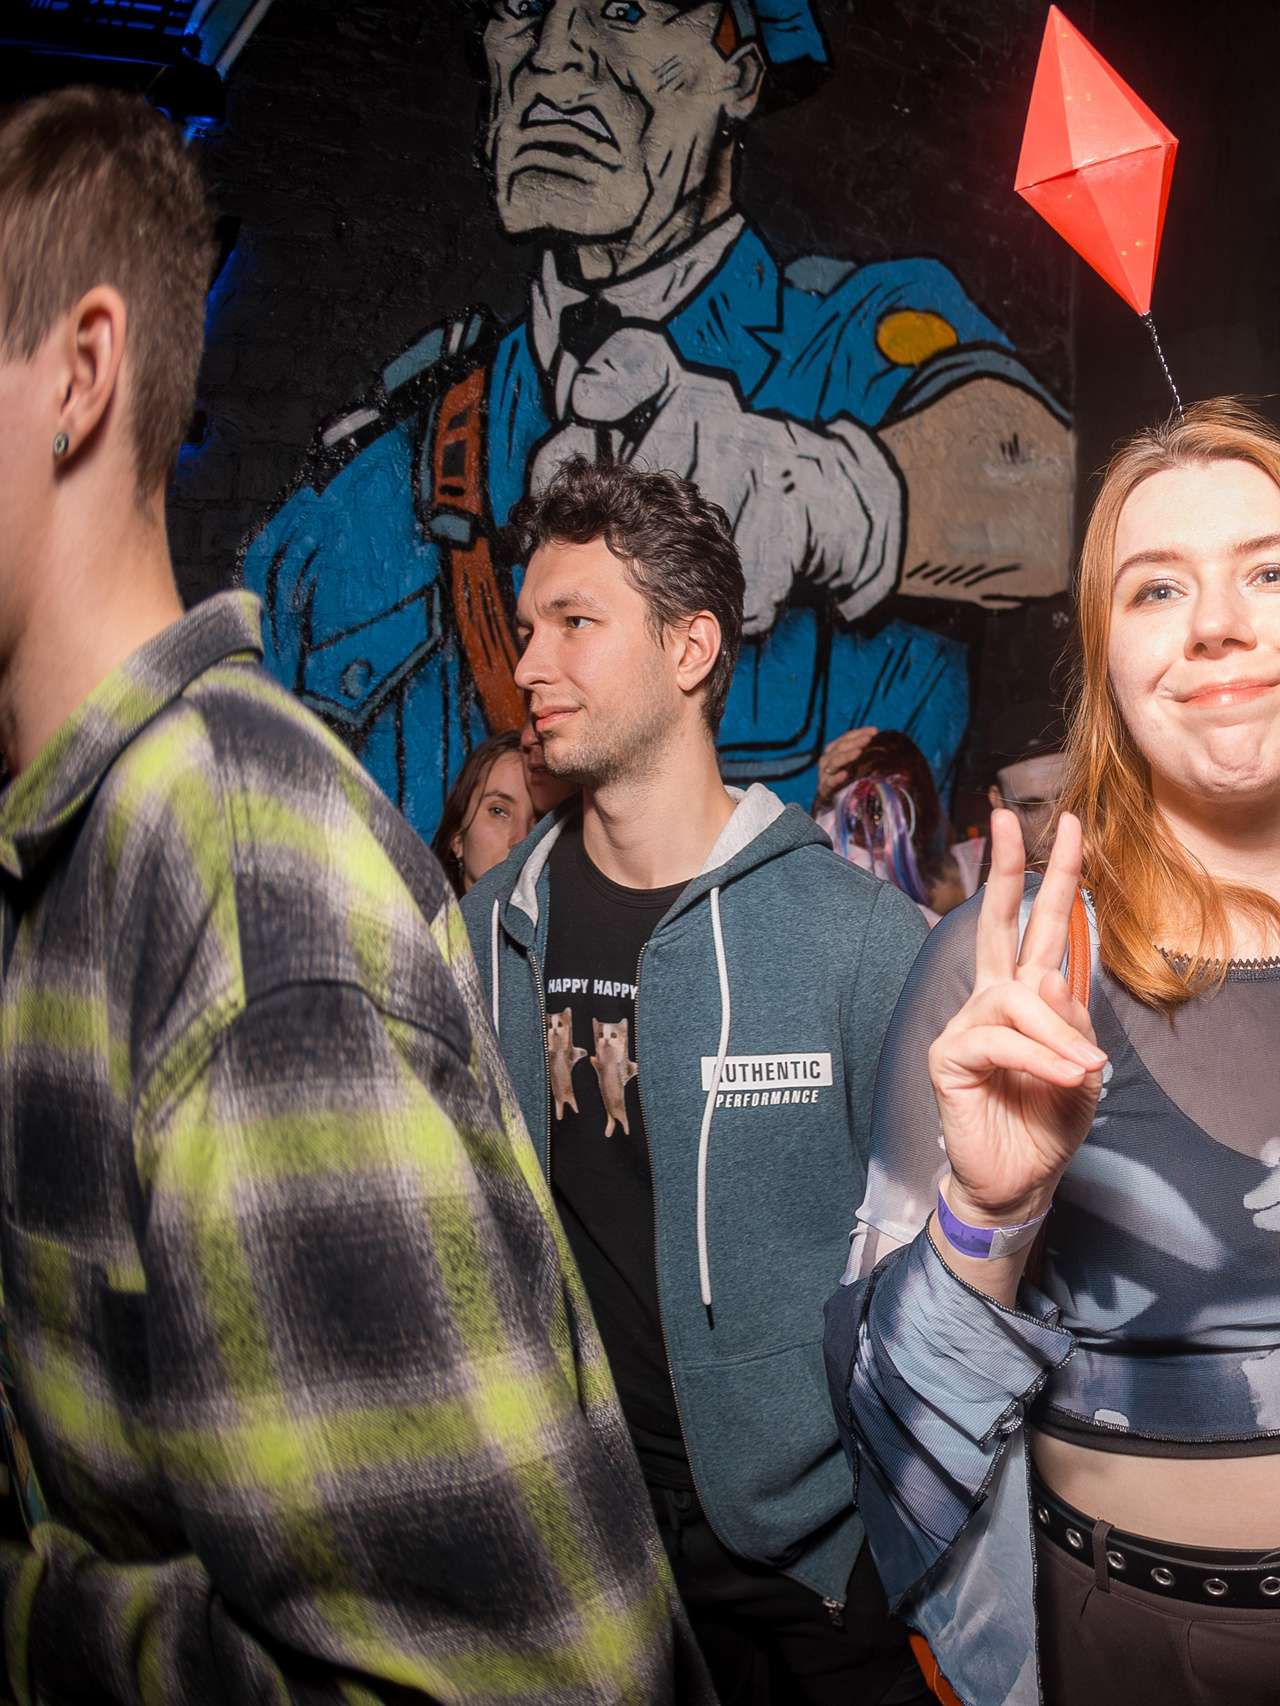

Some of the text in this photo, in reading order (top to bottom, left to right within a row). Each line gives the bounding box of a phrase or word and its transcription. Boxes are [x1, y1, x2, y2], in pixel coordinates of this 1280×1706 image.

[548, 978, 638, 1000] HAPPY HAPPY
[715, 1090, 819, 1108] PERFORMANCE
